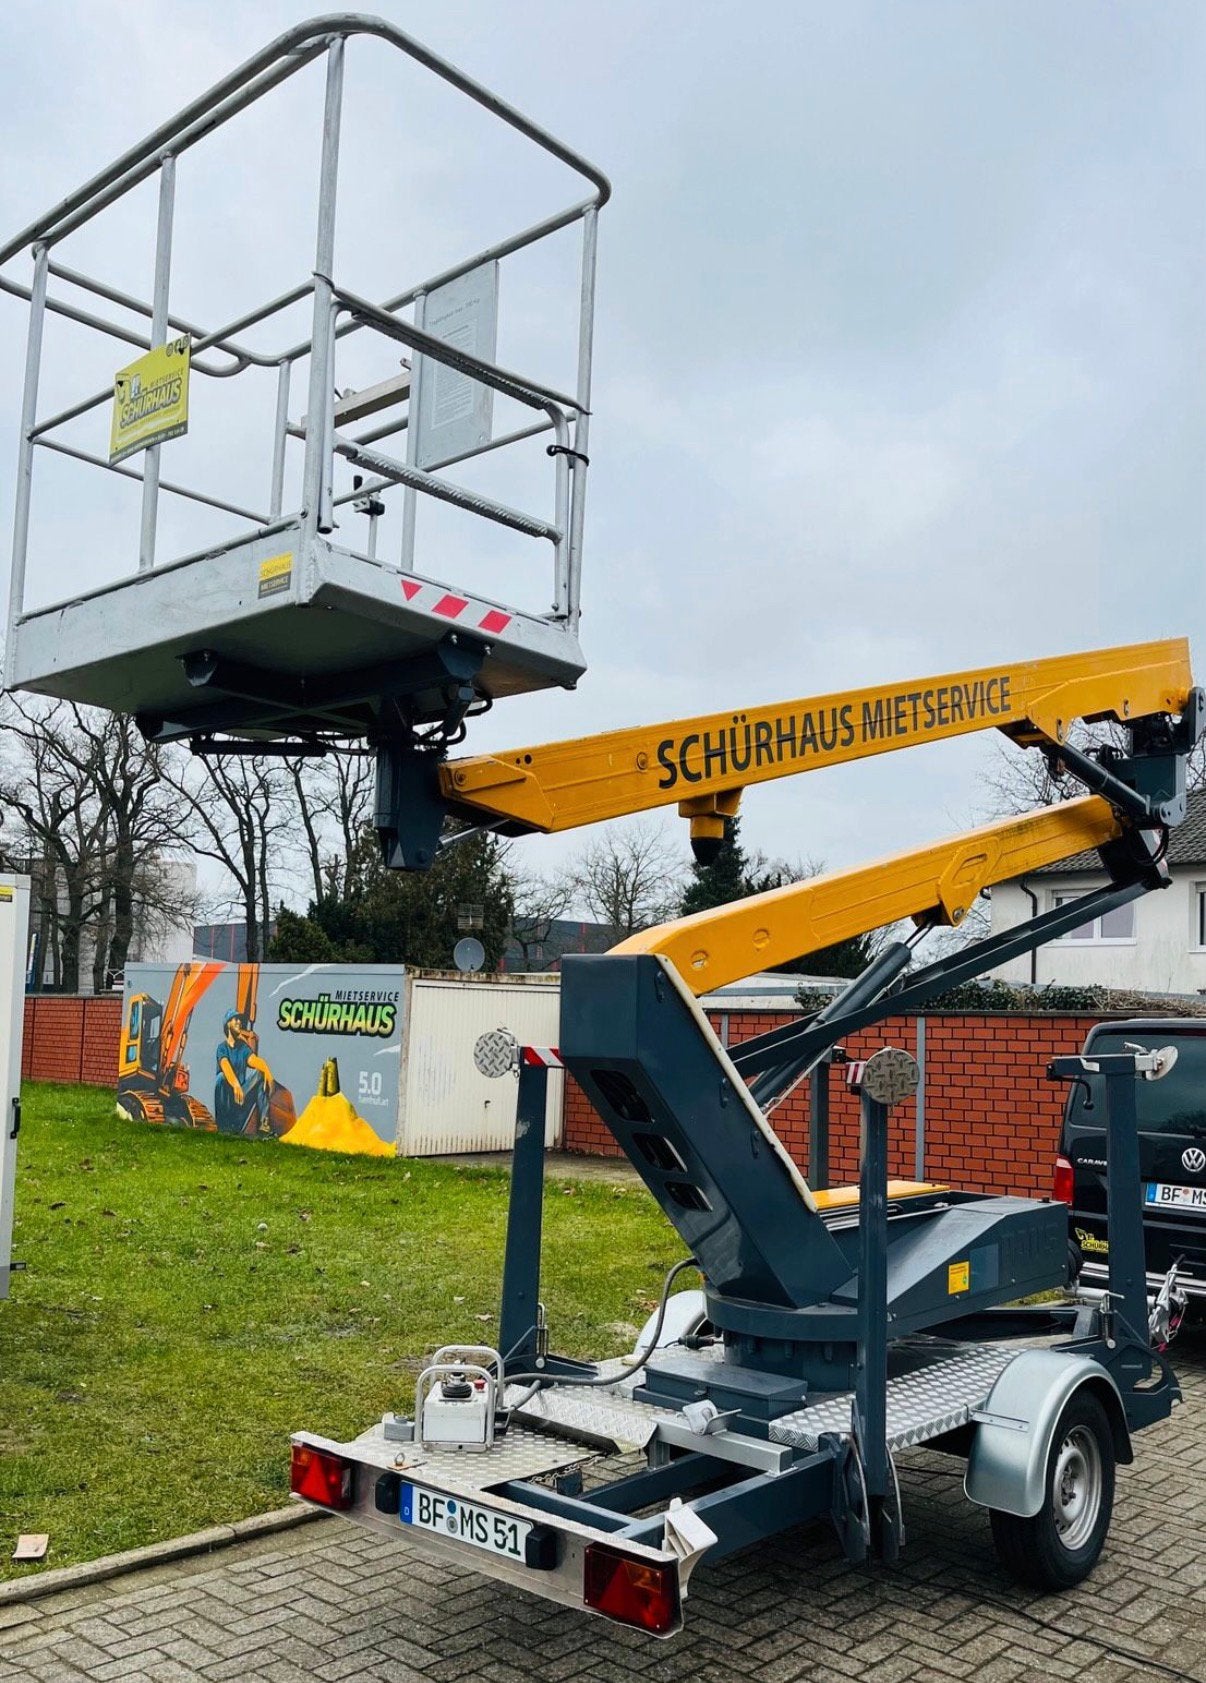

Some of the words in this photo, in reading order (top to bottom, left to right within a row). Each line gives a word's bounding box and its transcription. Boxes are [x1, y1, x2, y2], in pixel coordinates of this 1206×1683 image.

[658, 705, 854, 789] SCHÜRHAUS
[862, 676, 1012, 743] MIETSERVICE
[335, 989, 400, 1002] MIETSERVICE
[278, 994, 397, 1037] SCHÜRHAUS
[359, 1070, 382, 1095] 5.0
[1161, 1186, 1183, 1202] BF
[419, 1493, 446, 1527] BF
[460, 1506, 488, 1543] MS
[494, 1517, 521, 1556] 51
